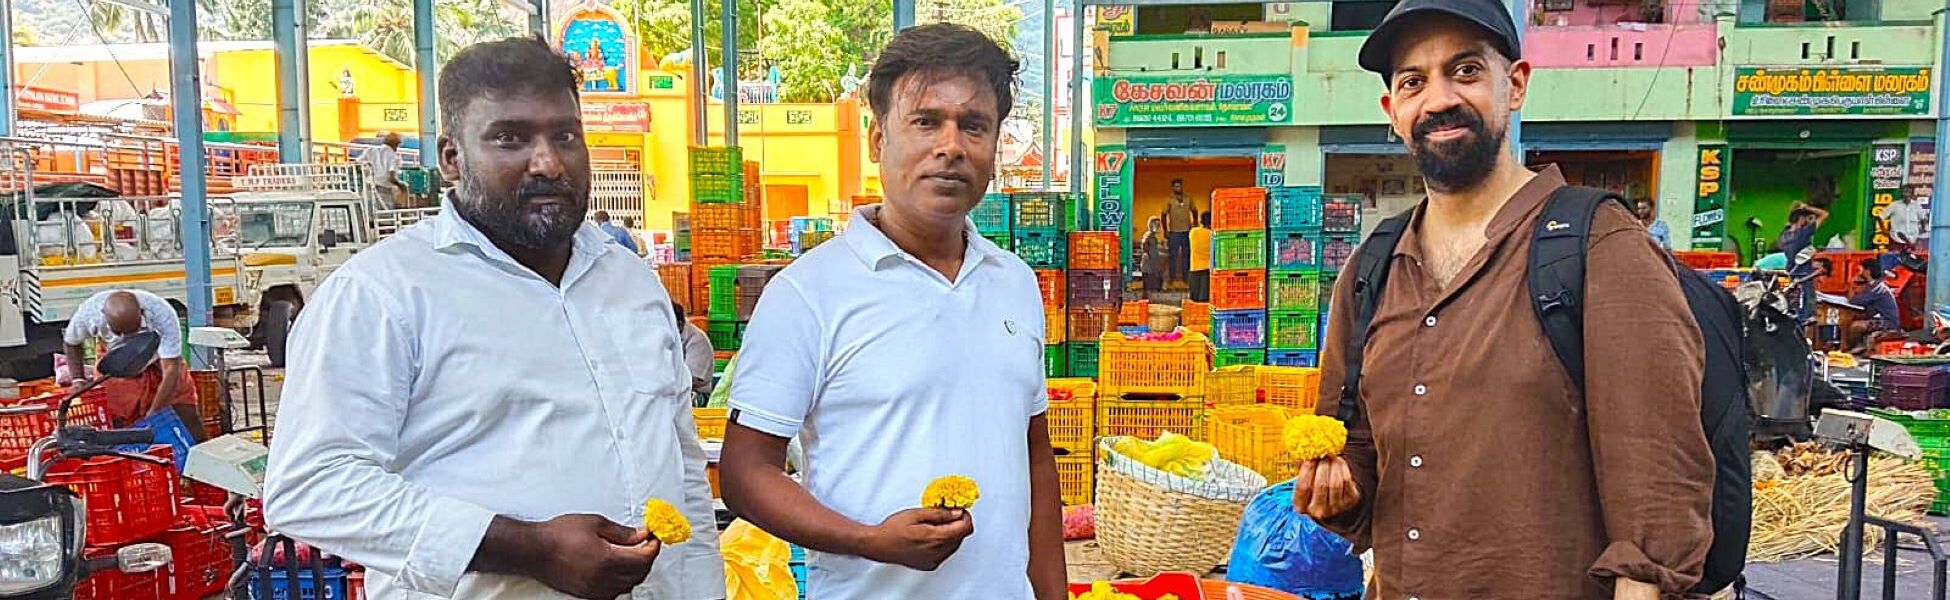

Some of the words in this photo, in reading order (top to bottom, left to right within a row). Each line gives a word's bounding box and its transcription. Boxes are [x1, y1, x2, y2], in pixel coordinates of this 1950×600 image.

[1113, 79, 1216, 102] கேசவன்
[1219, 77, 1290, 104] மலரகம்
[1098, 103, 1118, 120] K7
[1270, 107, 1286, 118] 24
[1096, 152, 1126, 173] K7
[1261, 153, 1285, 170] K7
[1875, 149, 1897, 161] KSP
[1699, 149, 1721, 197] KSP
